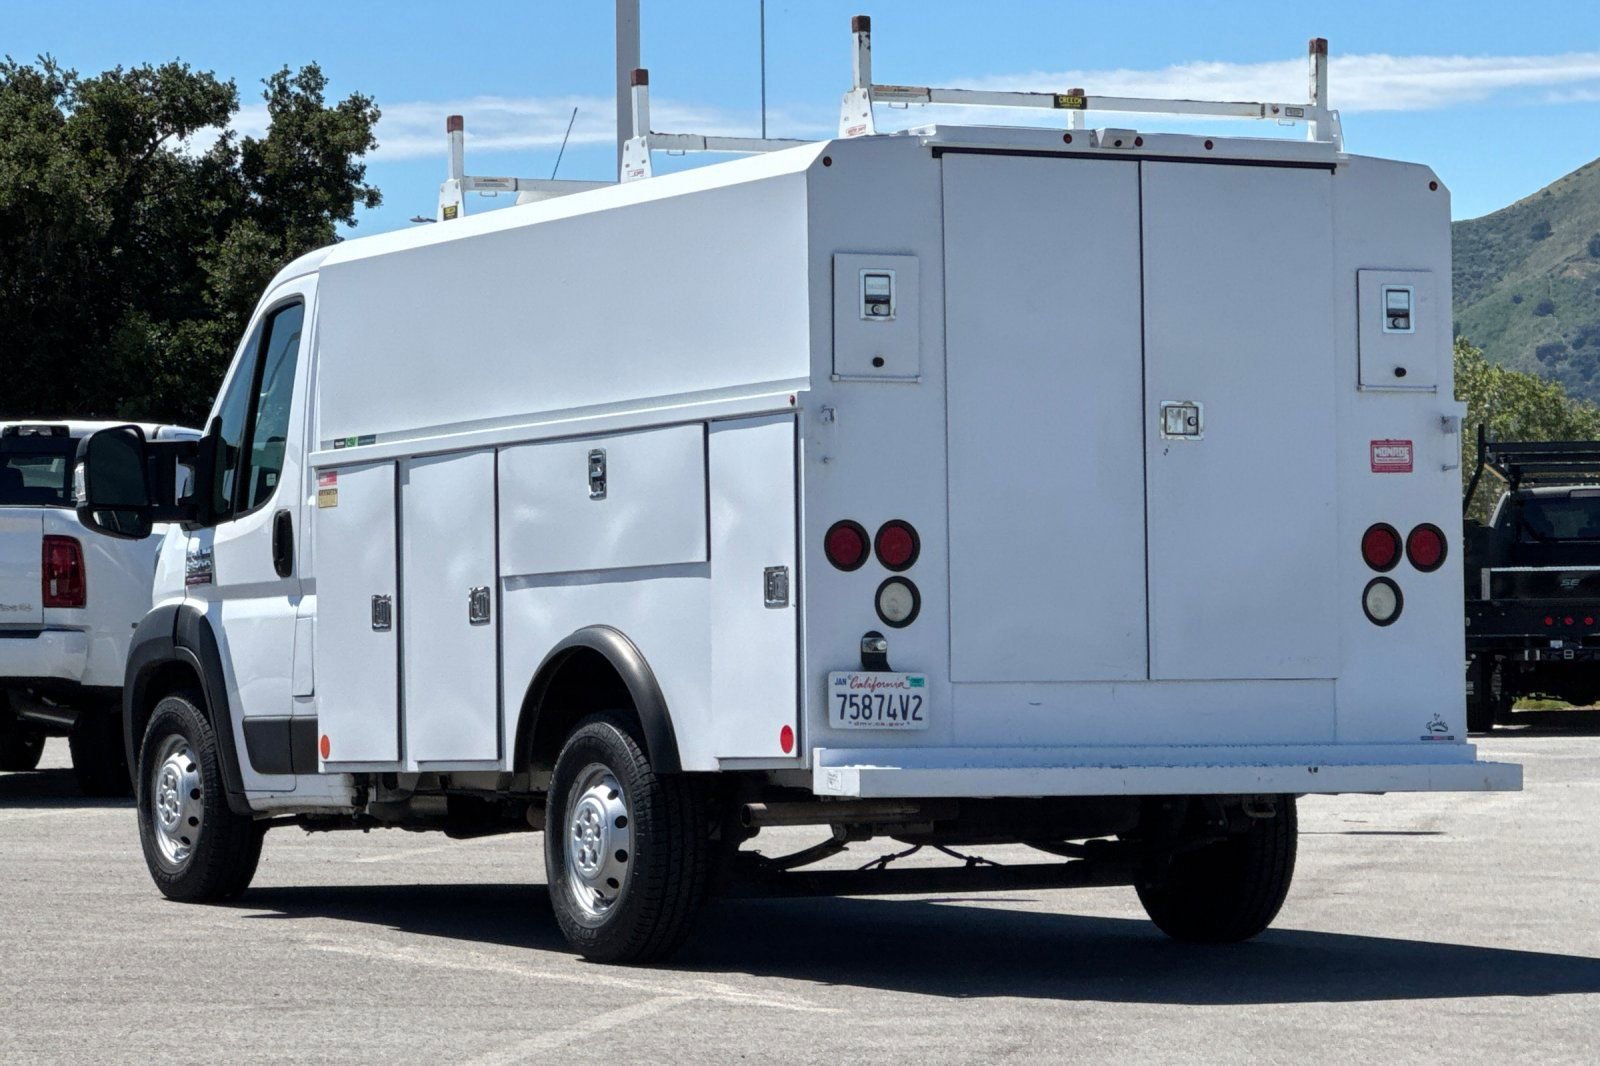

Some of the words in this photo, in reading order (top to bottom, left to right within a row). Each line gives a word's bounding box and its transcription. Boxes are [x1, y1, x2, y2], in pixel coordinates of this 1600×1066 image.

[835, 678, 846, 686] JAN
[849, 675, 911, 693] California
[836, 694, 923, 721] 75874V2
